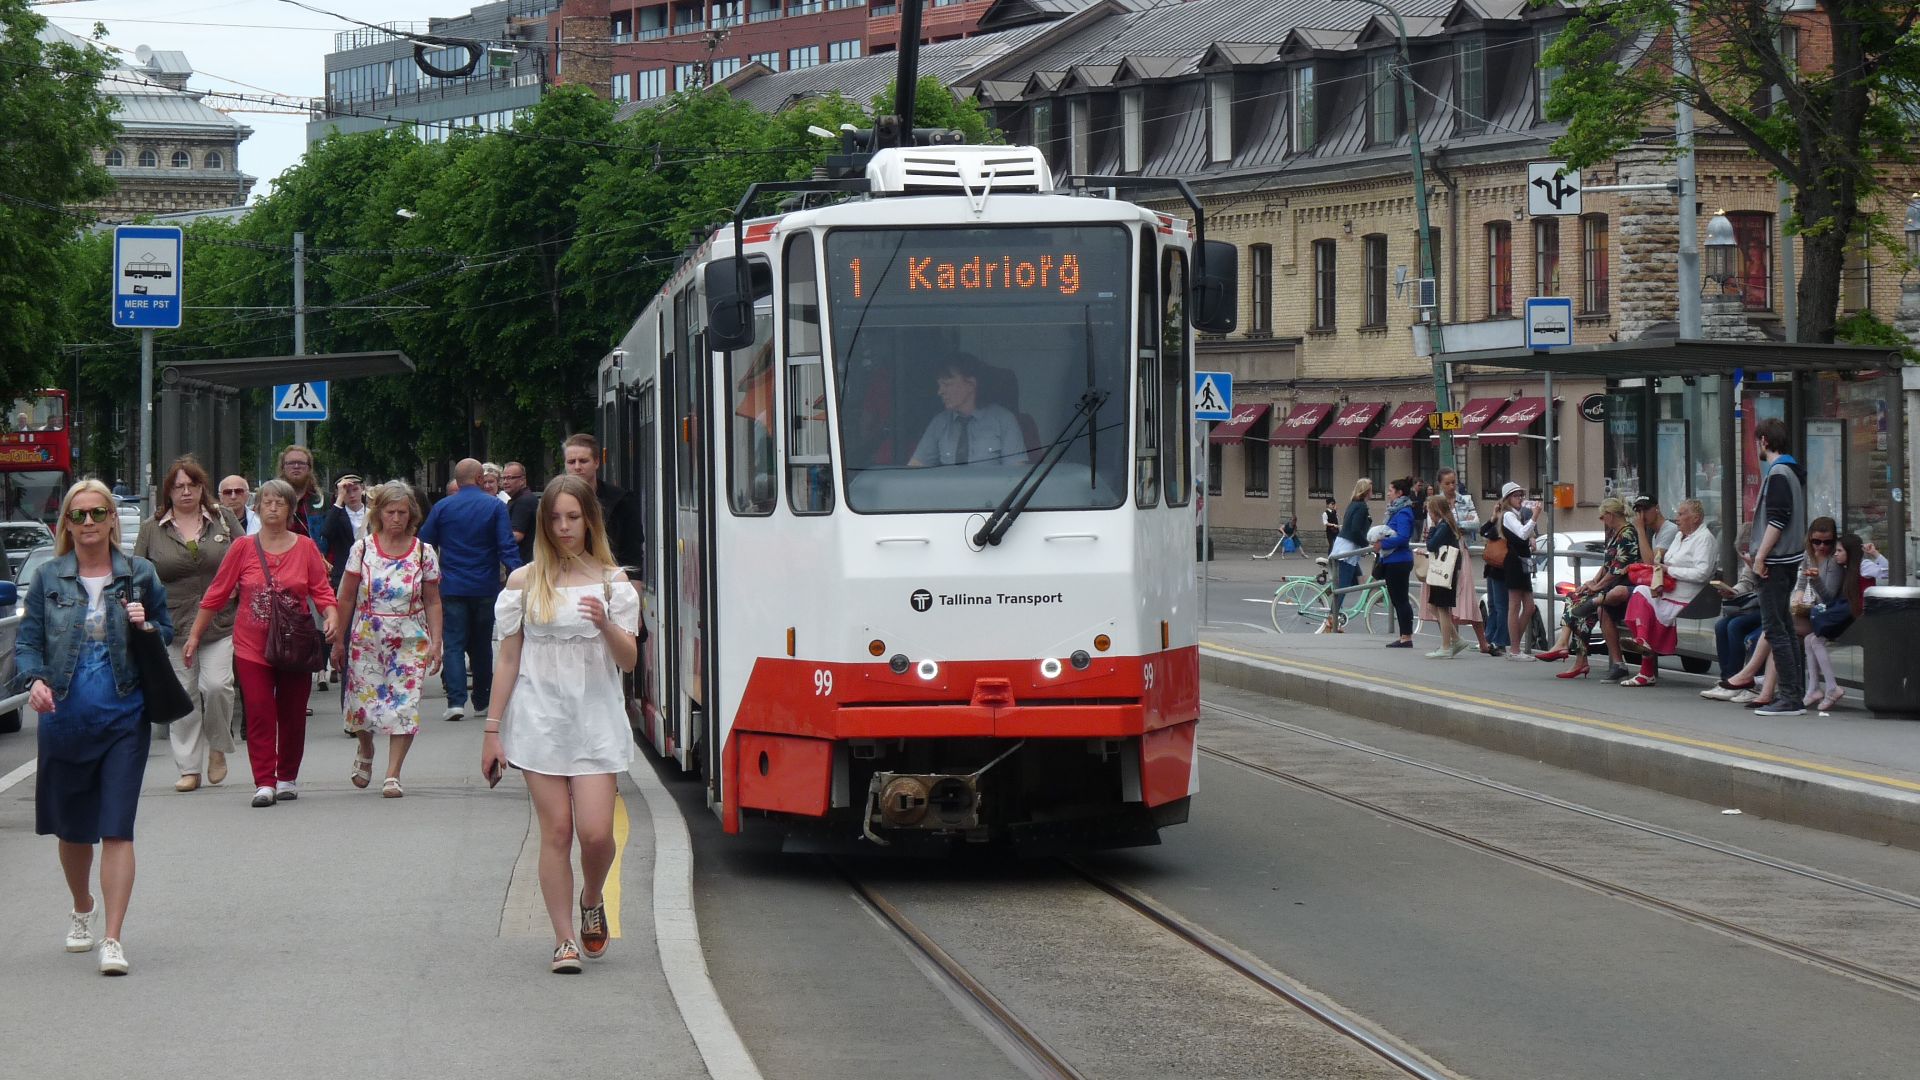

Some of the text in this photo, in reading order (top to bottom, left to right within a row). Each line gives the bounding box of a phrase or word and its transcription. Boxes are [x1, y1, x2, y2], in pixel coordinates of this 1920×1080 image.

[849, 253, 1081, 298] 1 Kadriorg
[118, 311, 135, 319] 1 2
[124, 300, 170, 309] MERE PST
[939, 592, 1063, 606] Tallinna Transport
[814, 669, 833, 697] 99
[1143, 662, 1154, 691] 99
